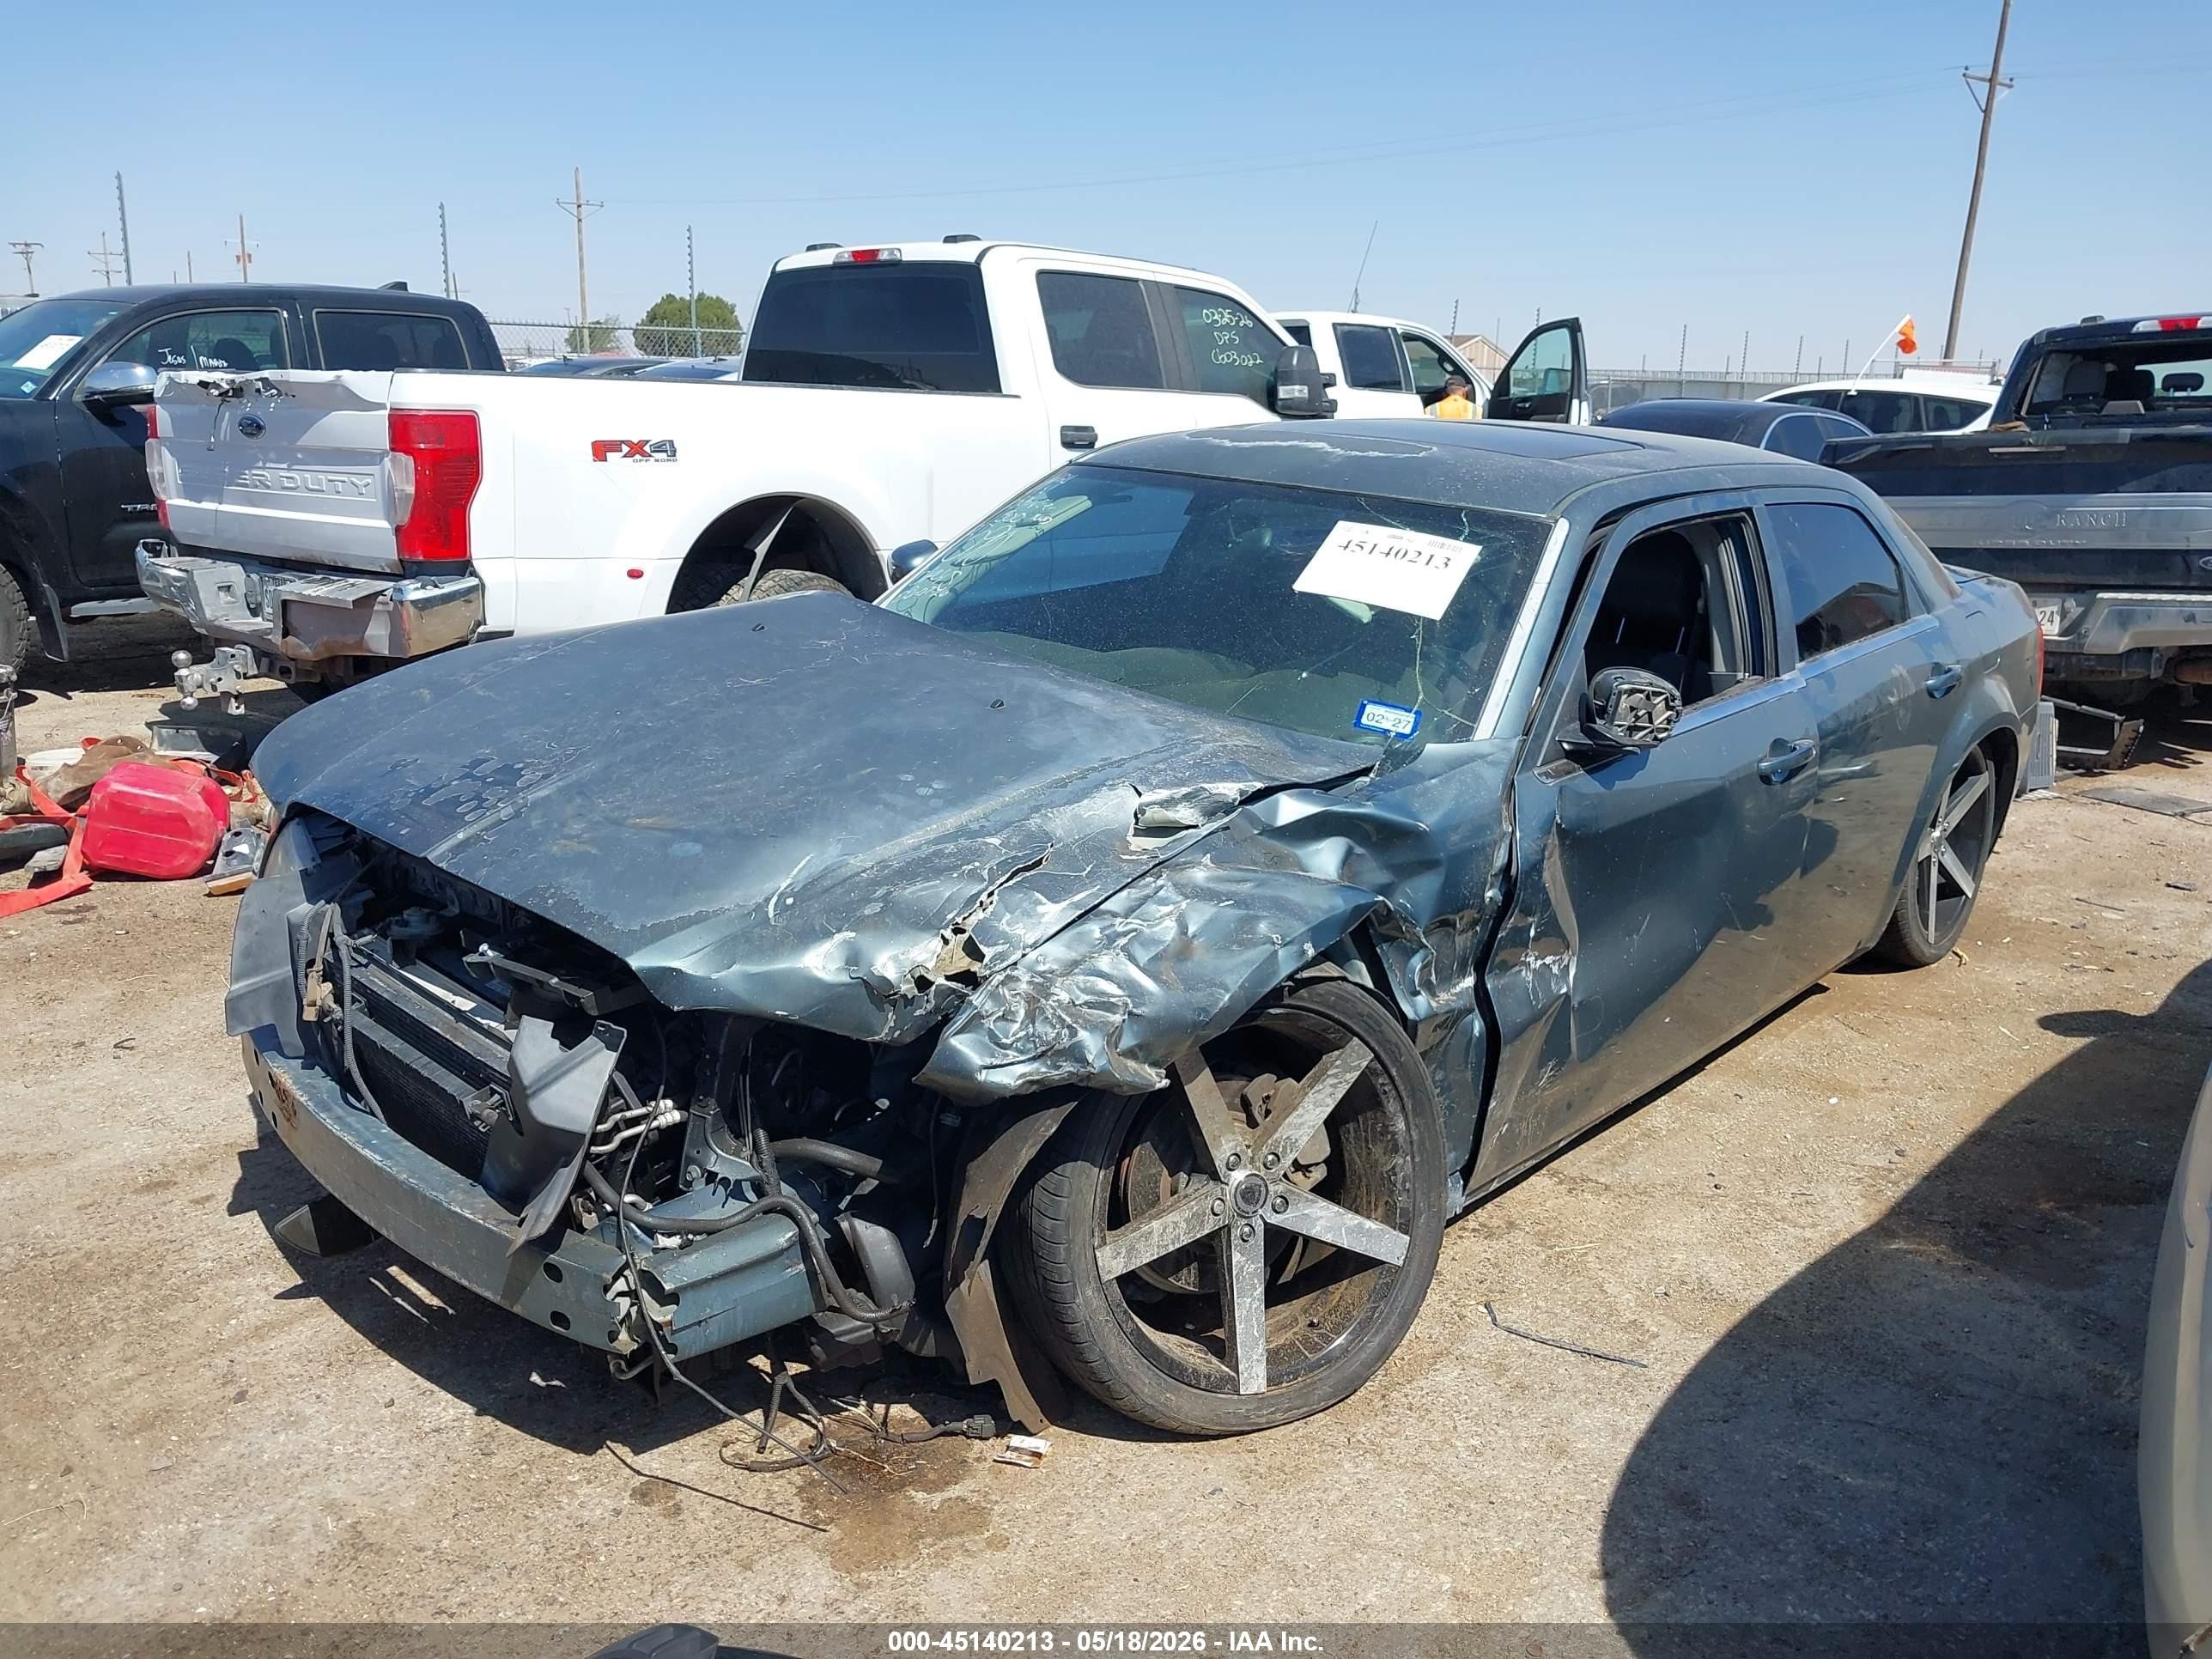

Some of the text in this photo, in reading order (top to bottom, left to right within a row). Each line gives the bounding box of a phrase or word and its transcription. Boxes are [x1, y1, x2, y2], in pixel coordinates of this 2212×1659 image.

[591, 440, 678, 462] FX4
[279, 472, 372, 495] DUTY
[1338, 538, 1452, 569] 45140213
